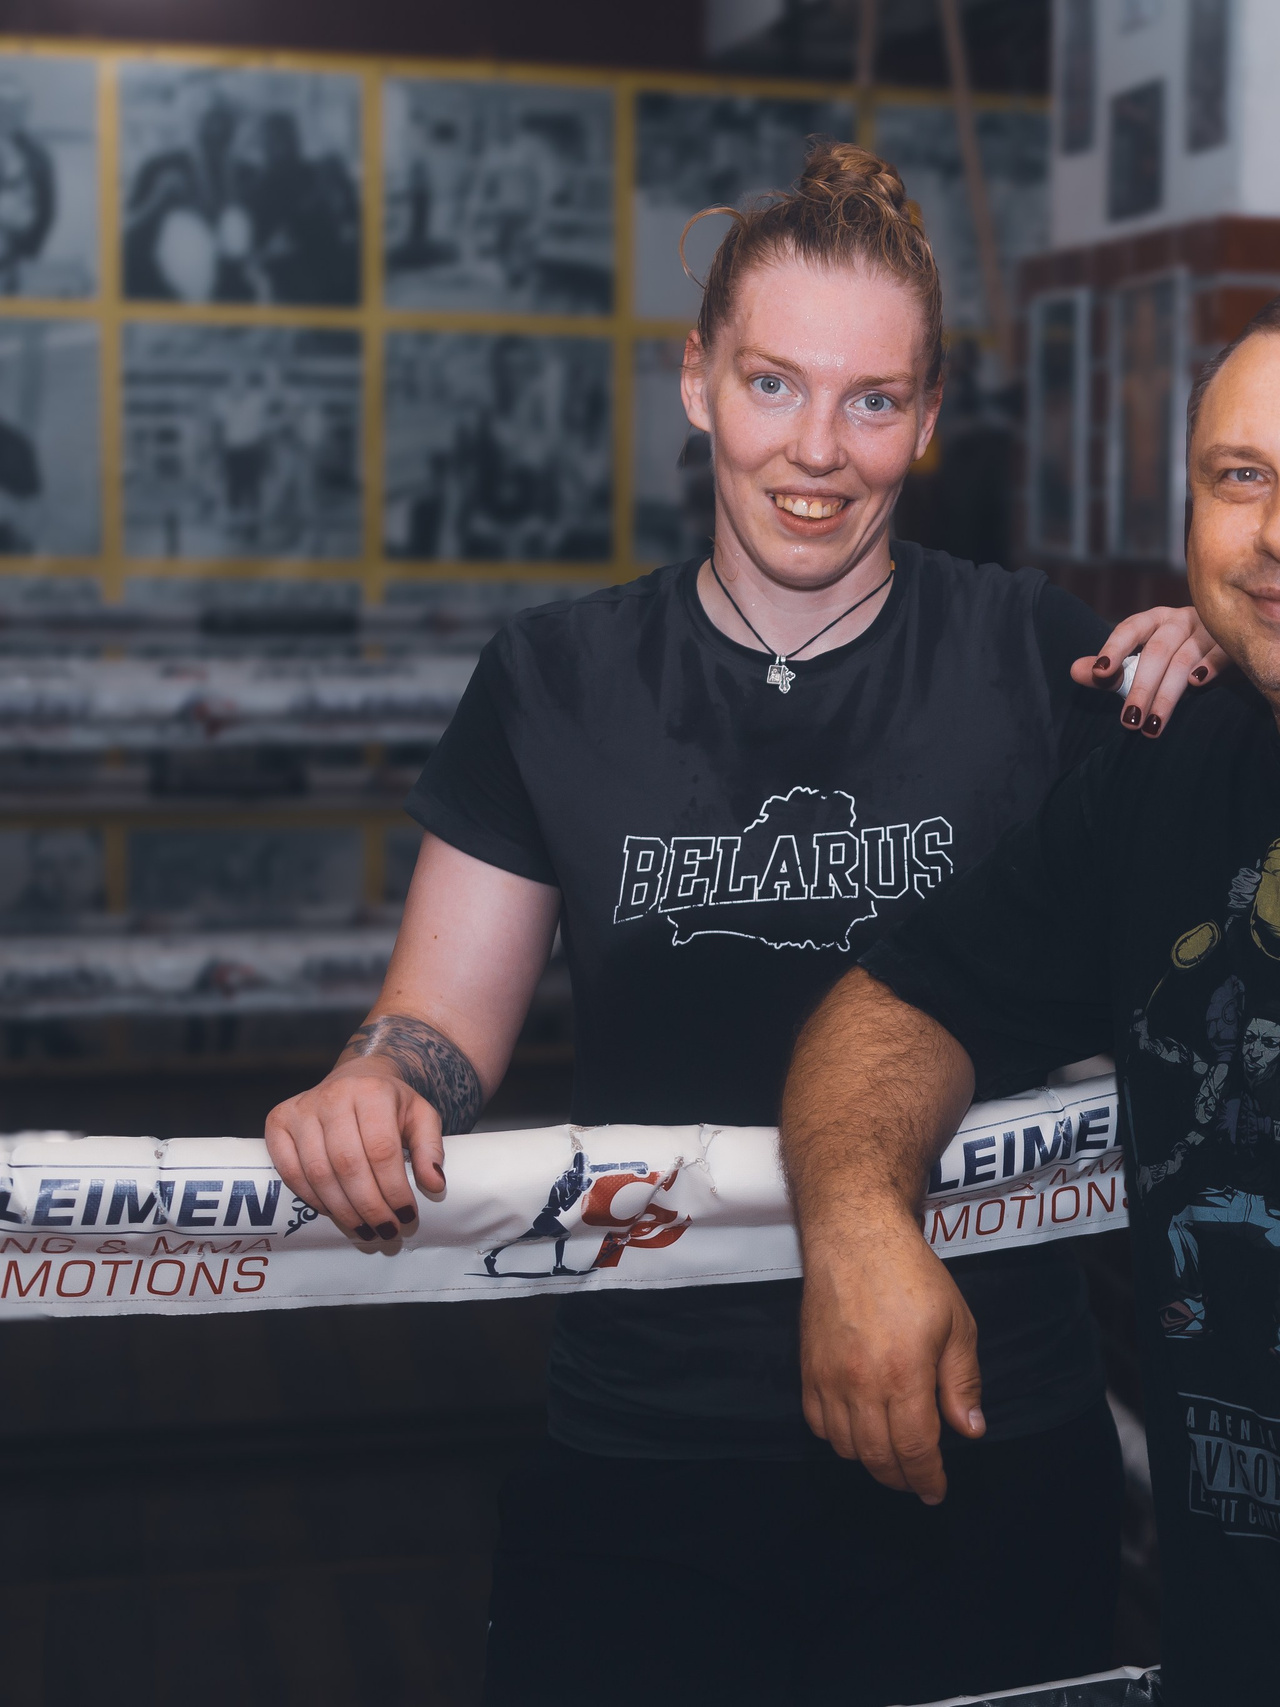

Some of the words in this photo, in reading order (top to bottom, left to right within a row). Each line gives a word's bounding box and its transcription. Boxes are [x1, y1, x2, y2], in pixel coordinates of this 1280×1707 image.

[613, 816, 954, 924] BELARUS
[927, 1105, 1124, 1194] LEIME
[0, 1178, 282, 1228] LEIMEN
[920, 1177, 1129, 1245] MOTION
[95, 1239, 130, 1255] &
[150, 1236, 272, 1257] MMA
[1, 1256, 270, 1299] MOTIONS
